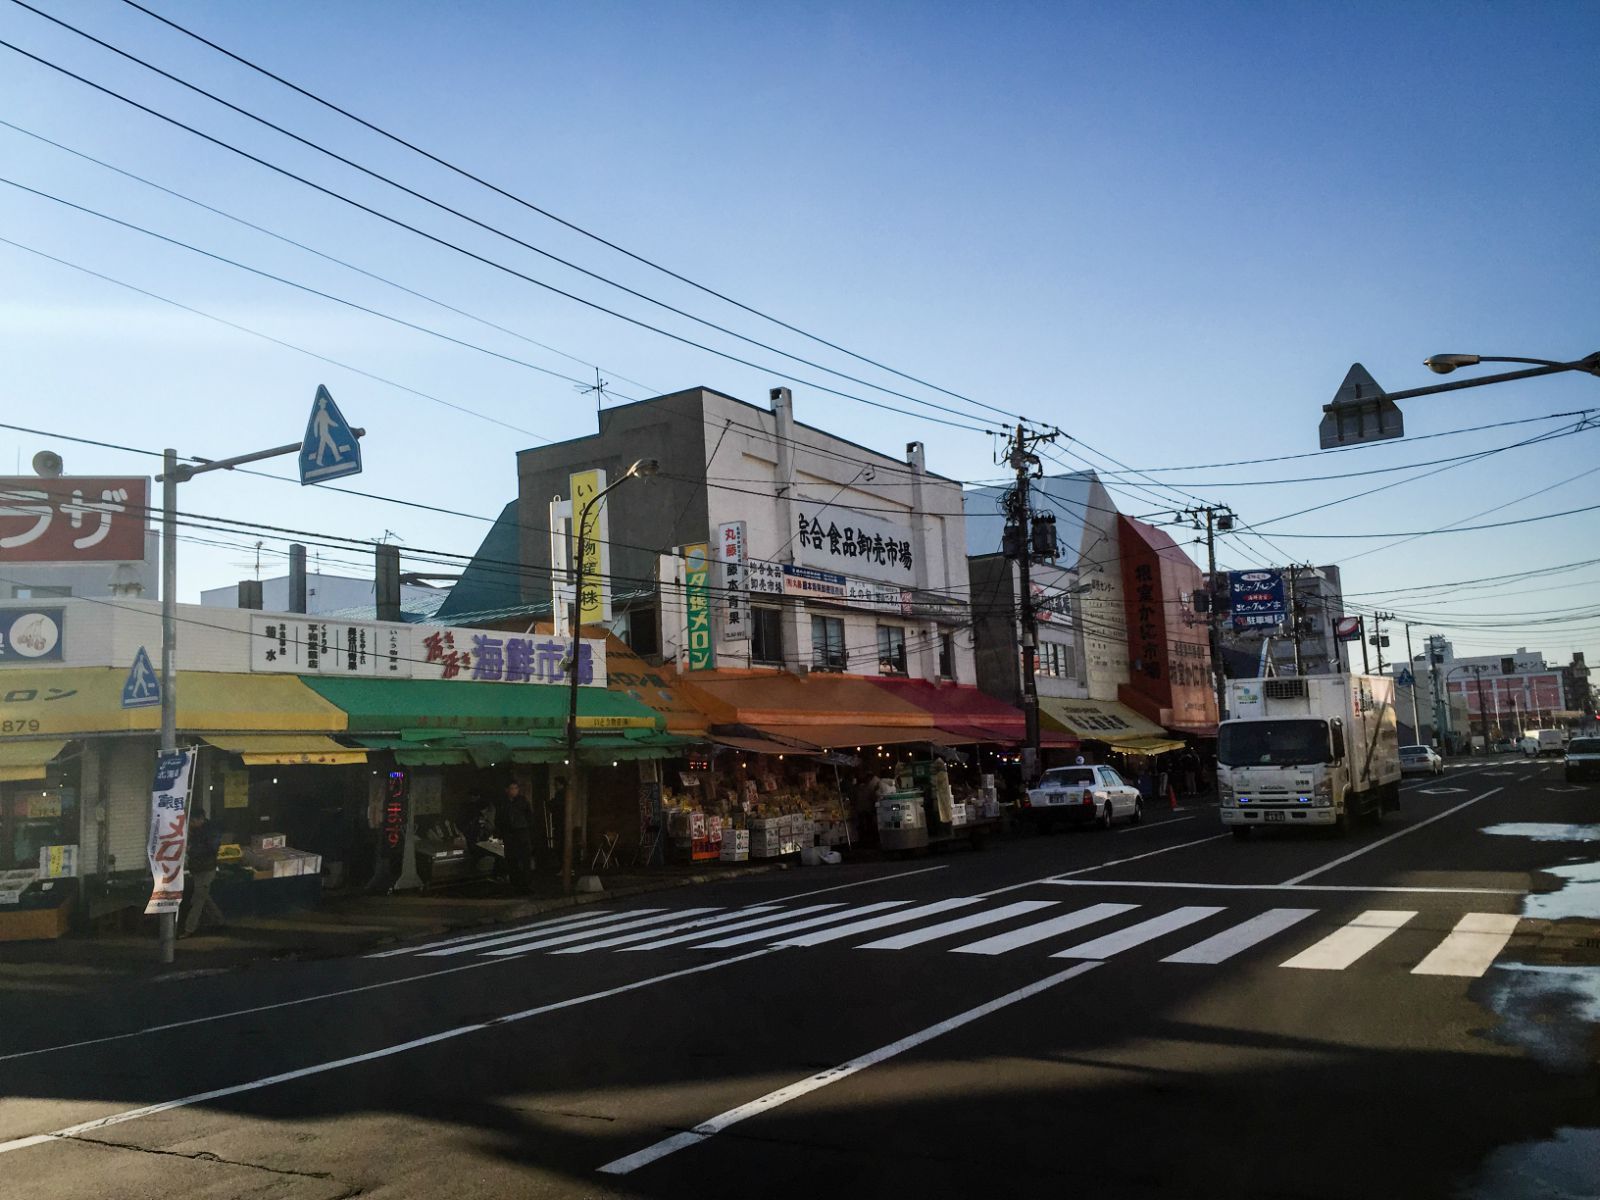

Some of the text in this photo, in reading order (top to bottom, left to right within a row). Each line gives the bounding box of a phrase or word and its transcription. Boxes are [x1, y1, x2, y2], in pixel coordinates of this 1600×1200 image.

[0, 488, 128, 549] ラザ
[725, 528, 737, 557] 丸藤
[727, 563, 740, 625] 藤本青果
[751, 577, 783, 593] 卸売市場
[2, 719, 40, 732] 879
[155, 814, 186, 883] メロン
